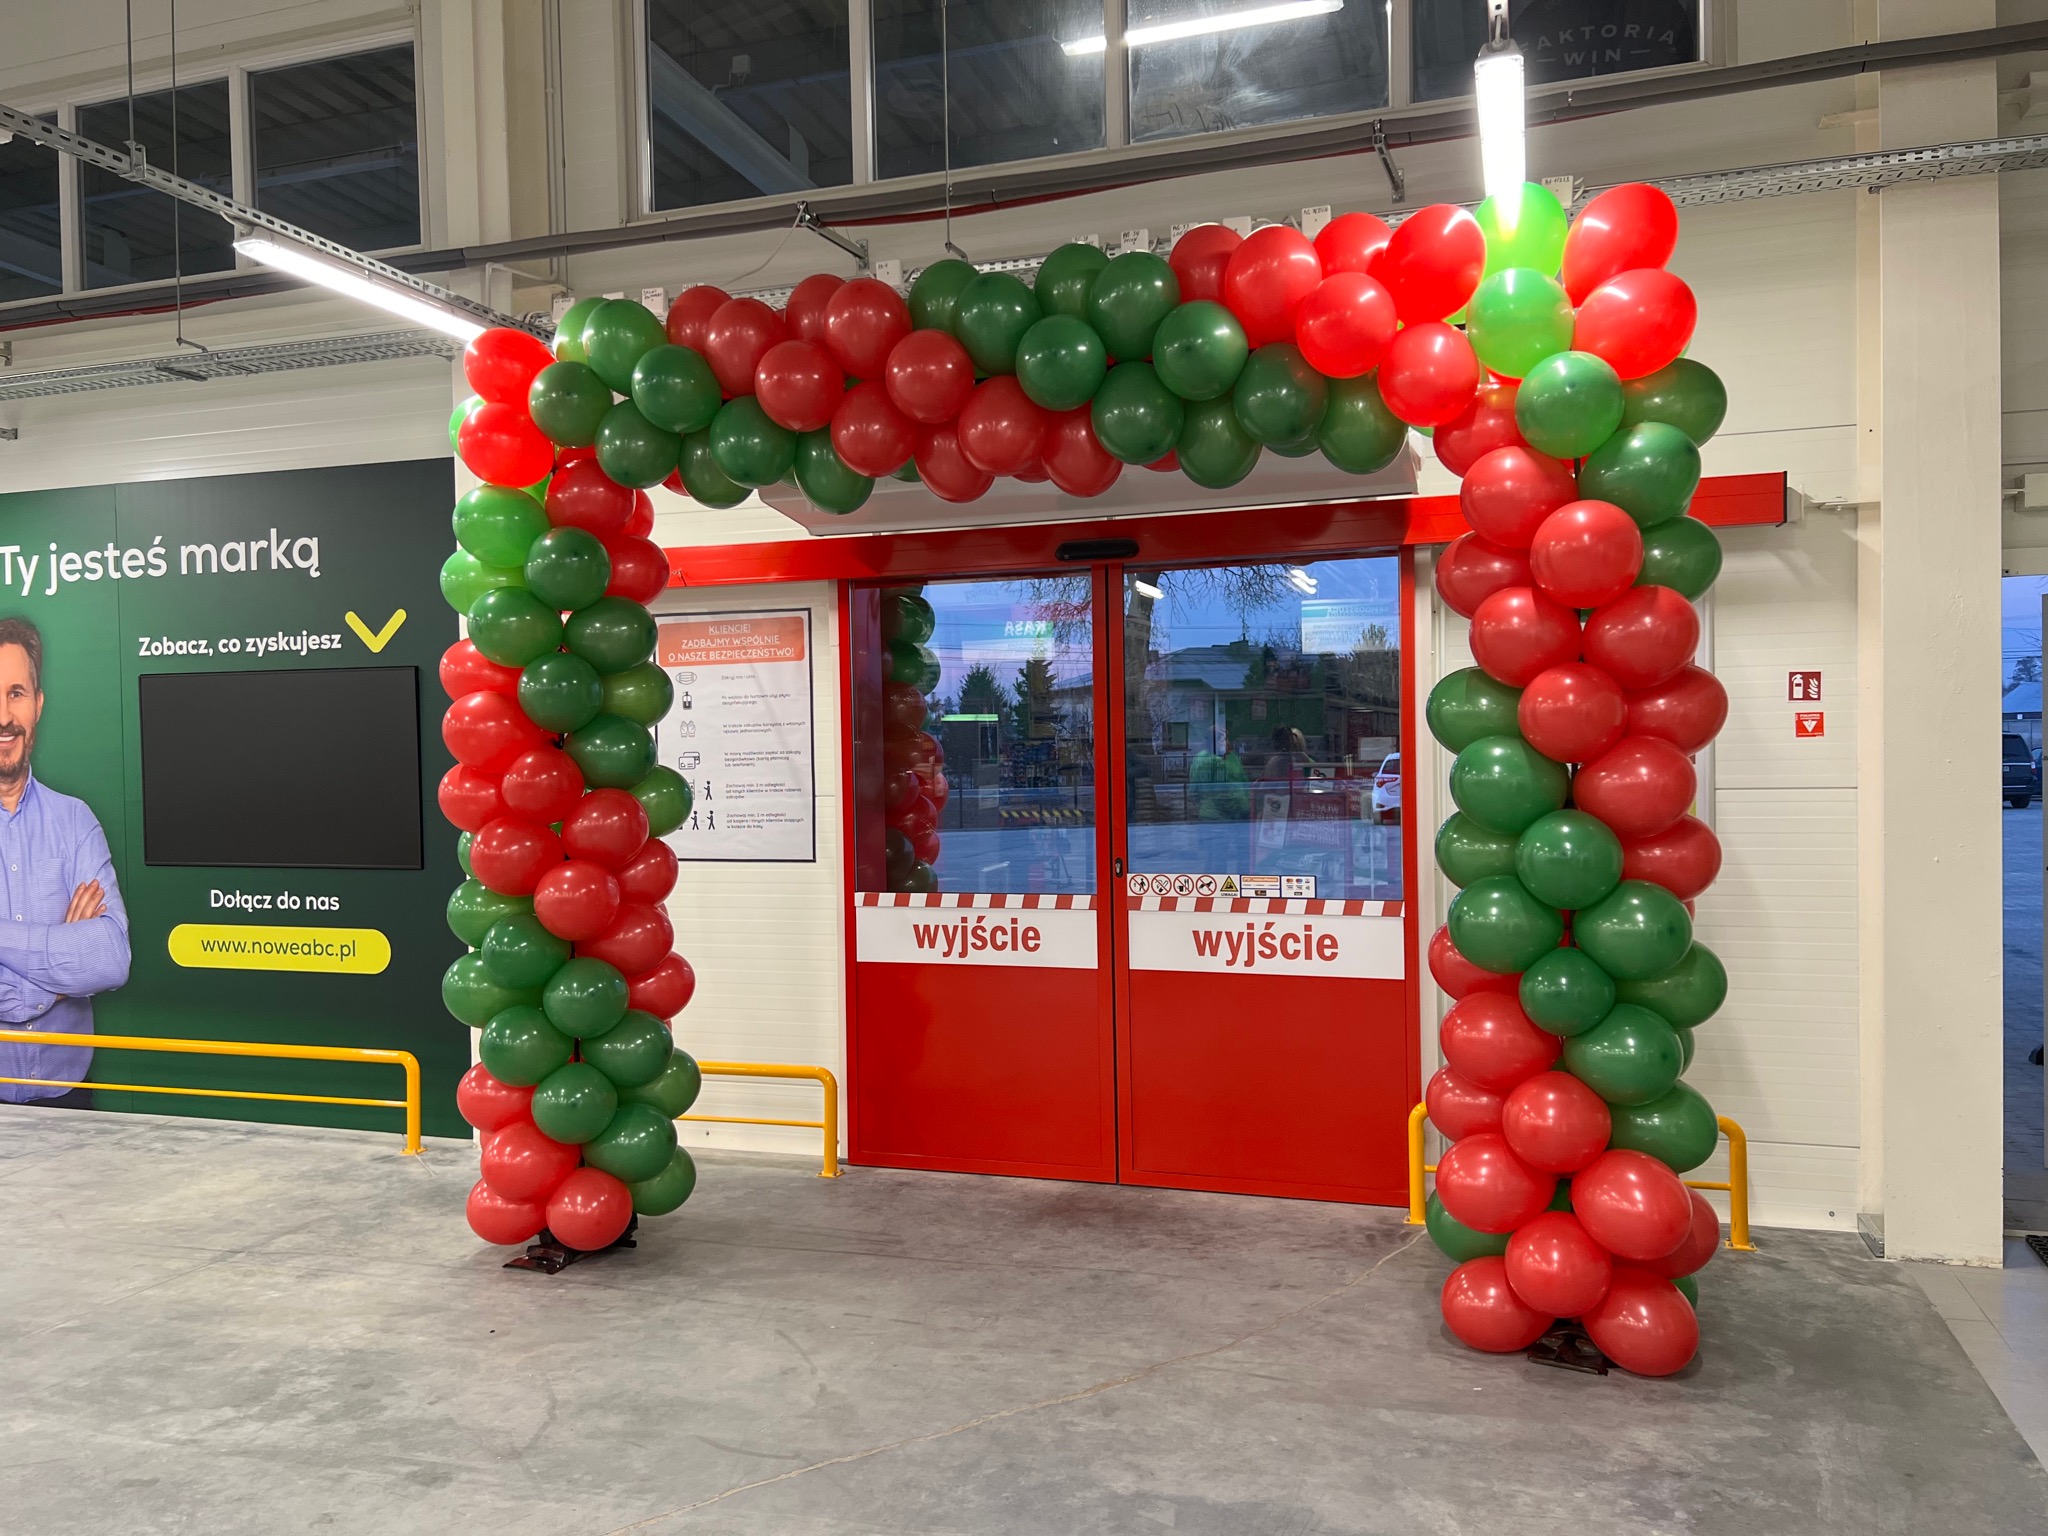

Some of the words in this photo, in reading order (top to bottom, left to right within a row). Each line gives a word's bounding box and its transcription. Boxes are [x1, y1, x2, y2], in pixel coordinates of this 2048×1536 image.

[1564, 48, 1621, 66] WIN
[0, 545, 39, 596] Ty
[44, 536, 168, 596] jesteś
[180, 528, 321, 578] marką
[708, 624, 751, 634] KLIENCIE!
[139, 636, 214, 657] Zobacz,
[218, 637, 241, 654] co
[246, 630, 342, 657] zyskujesz
[682, 638, 730, 649] ZADBAJMY
[732, 635, 780, 645] WSPÓLNIE
[668, 653, 676, 661] O
[678, 651, 706, 660] NASZE
[710, 647, 794, 659] BEZPIECZEŃSTWO!
[210, 889, 272, 912] Dołącz
[277, 891, 300, 910] do
[306, 896, 340, 910] nas
[912, 916, 1042, 958] wyjście
[1192, 922, 1340, 967] wyjście
[202, 939, 356, 962] www.noweabc.pl
